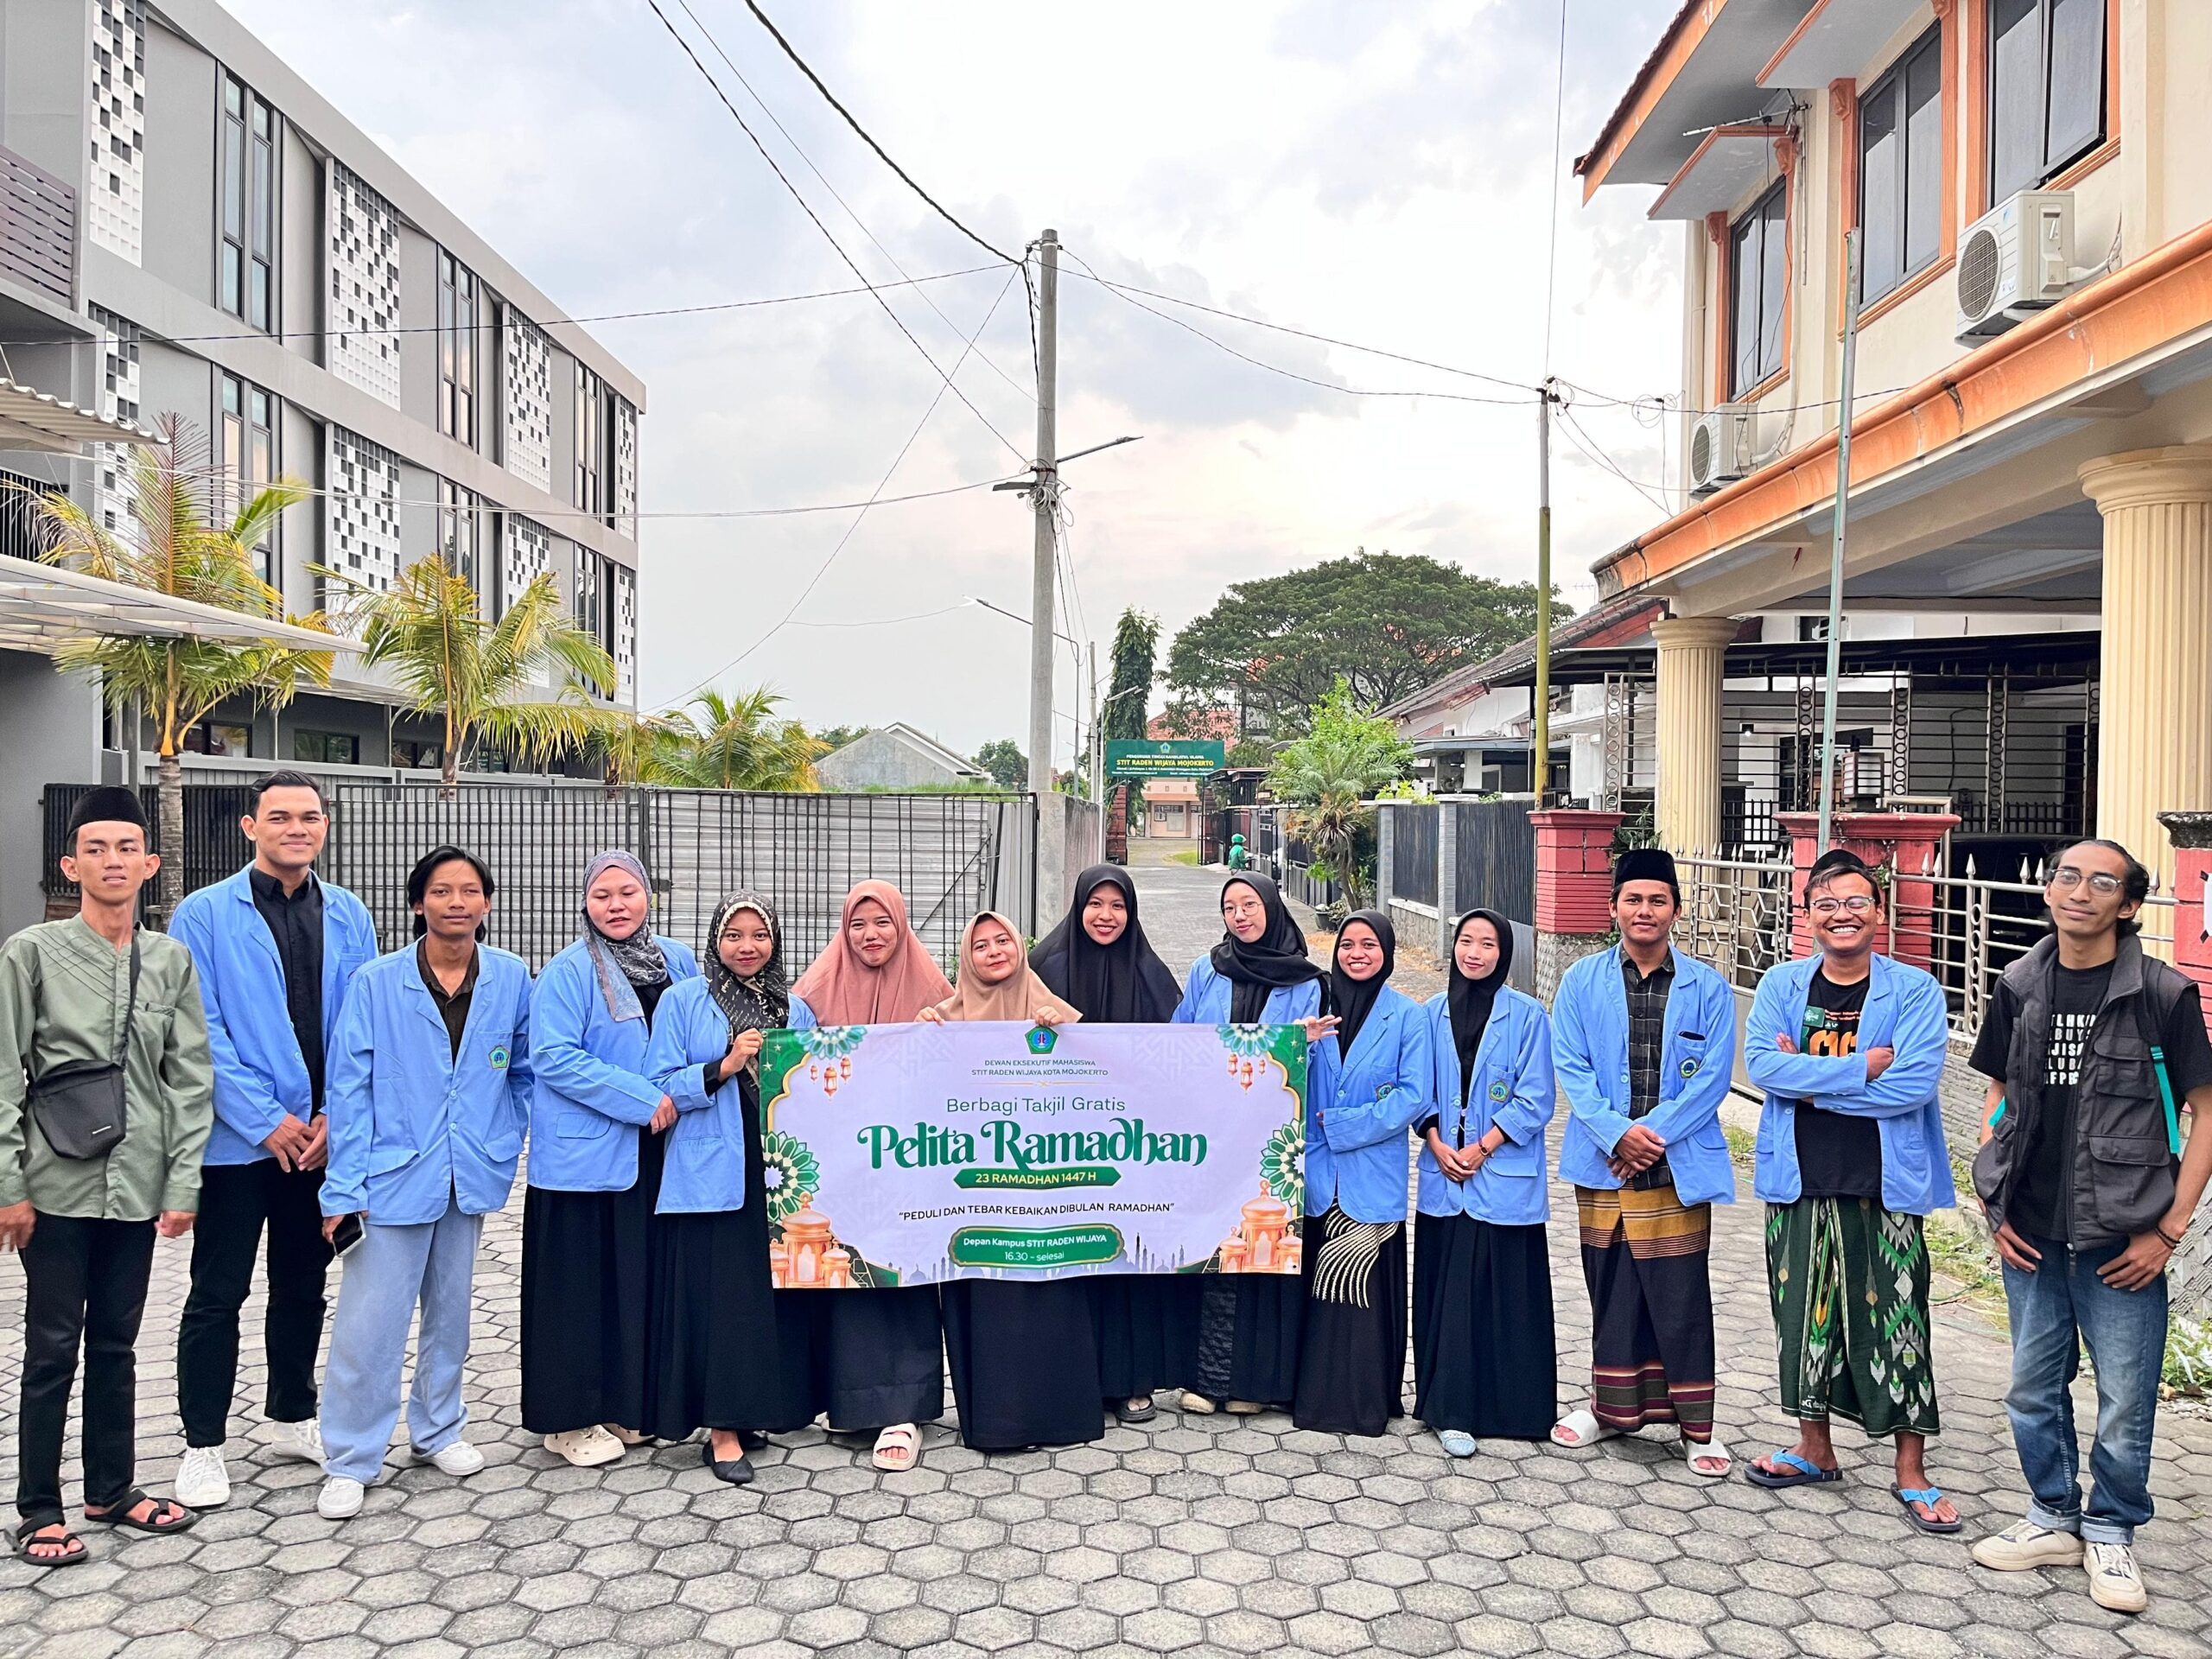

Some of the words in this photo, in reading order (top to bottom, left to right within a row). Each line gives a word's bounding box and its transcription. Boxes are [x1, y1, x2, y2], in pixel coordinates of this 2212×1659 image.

[946, 1096, 1018, 1116] Berbagi
[1021, 1096, 1065, 1116] Takjil
[1071, 1096, 1126, 1112] Gratis
[856, 1122, 977, 1169] Pelita
[980, 1117, 1208, 1171] Ramadhan
[975, 1173, 990, 1184] 23
[991, 1173, 1059, 1185] RAMADHAN
[1060, 1171, 1086, 1183] 1447
[1088, 1171, 1097, 1182] H
[943, 1205, 966, 1216] DAN
[967, 1205, 1003, 1215] TEBAR
[1004, 1205, 1058, 1216] KEBAIKAN
[1059, 1202, 1105, 1214] DIBULAN
[963, 1237, 991, 1248] Depan
[991, 1237, 1026, 1249] Kampus
[1026, 1238, 1046, 1248] STIT
[1046, 1236, 1075, 1247] RADEN
[1075, 1234, 1108, 1244] WIJAYA
[1004, 1250, 1028, 1262] 16.30
[1036, 1250, 1065, 1262] selesai
